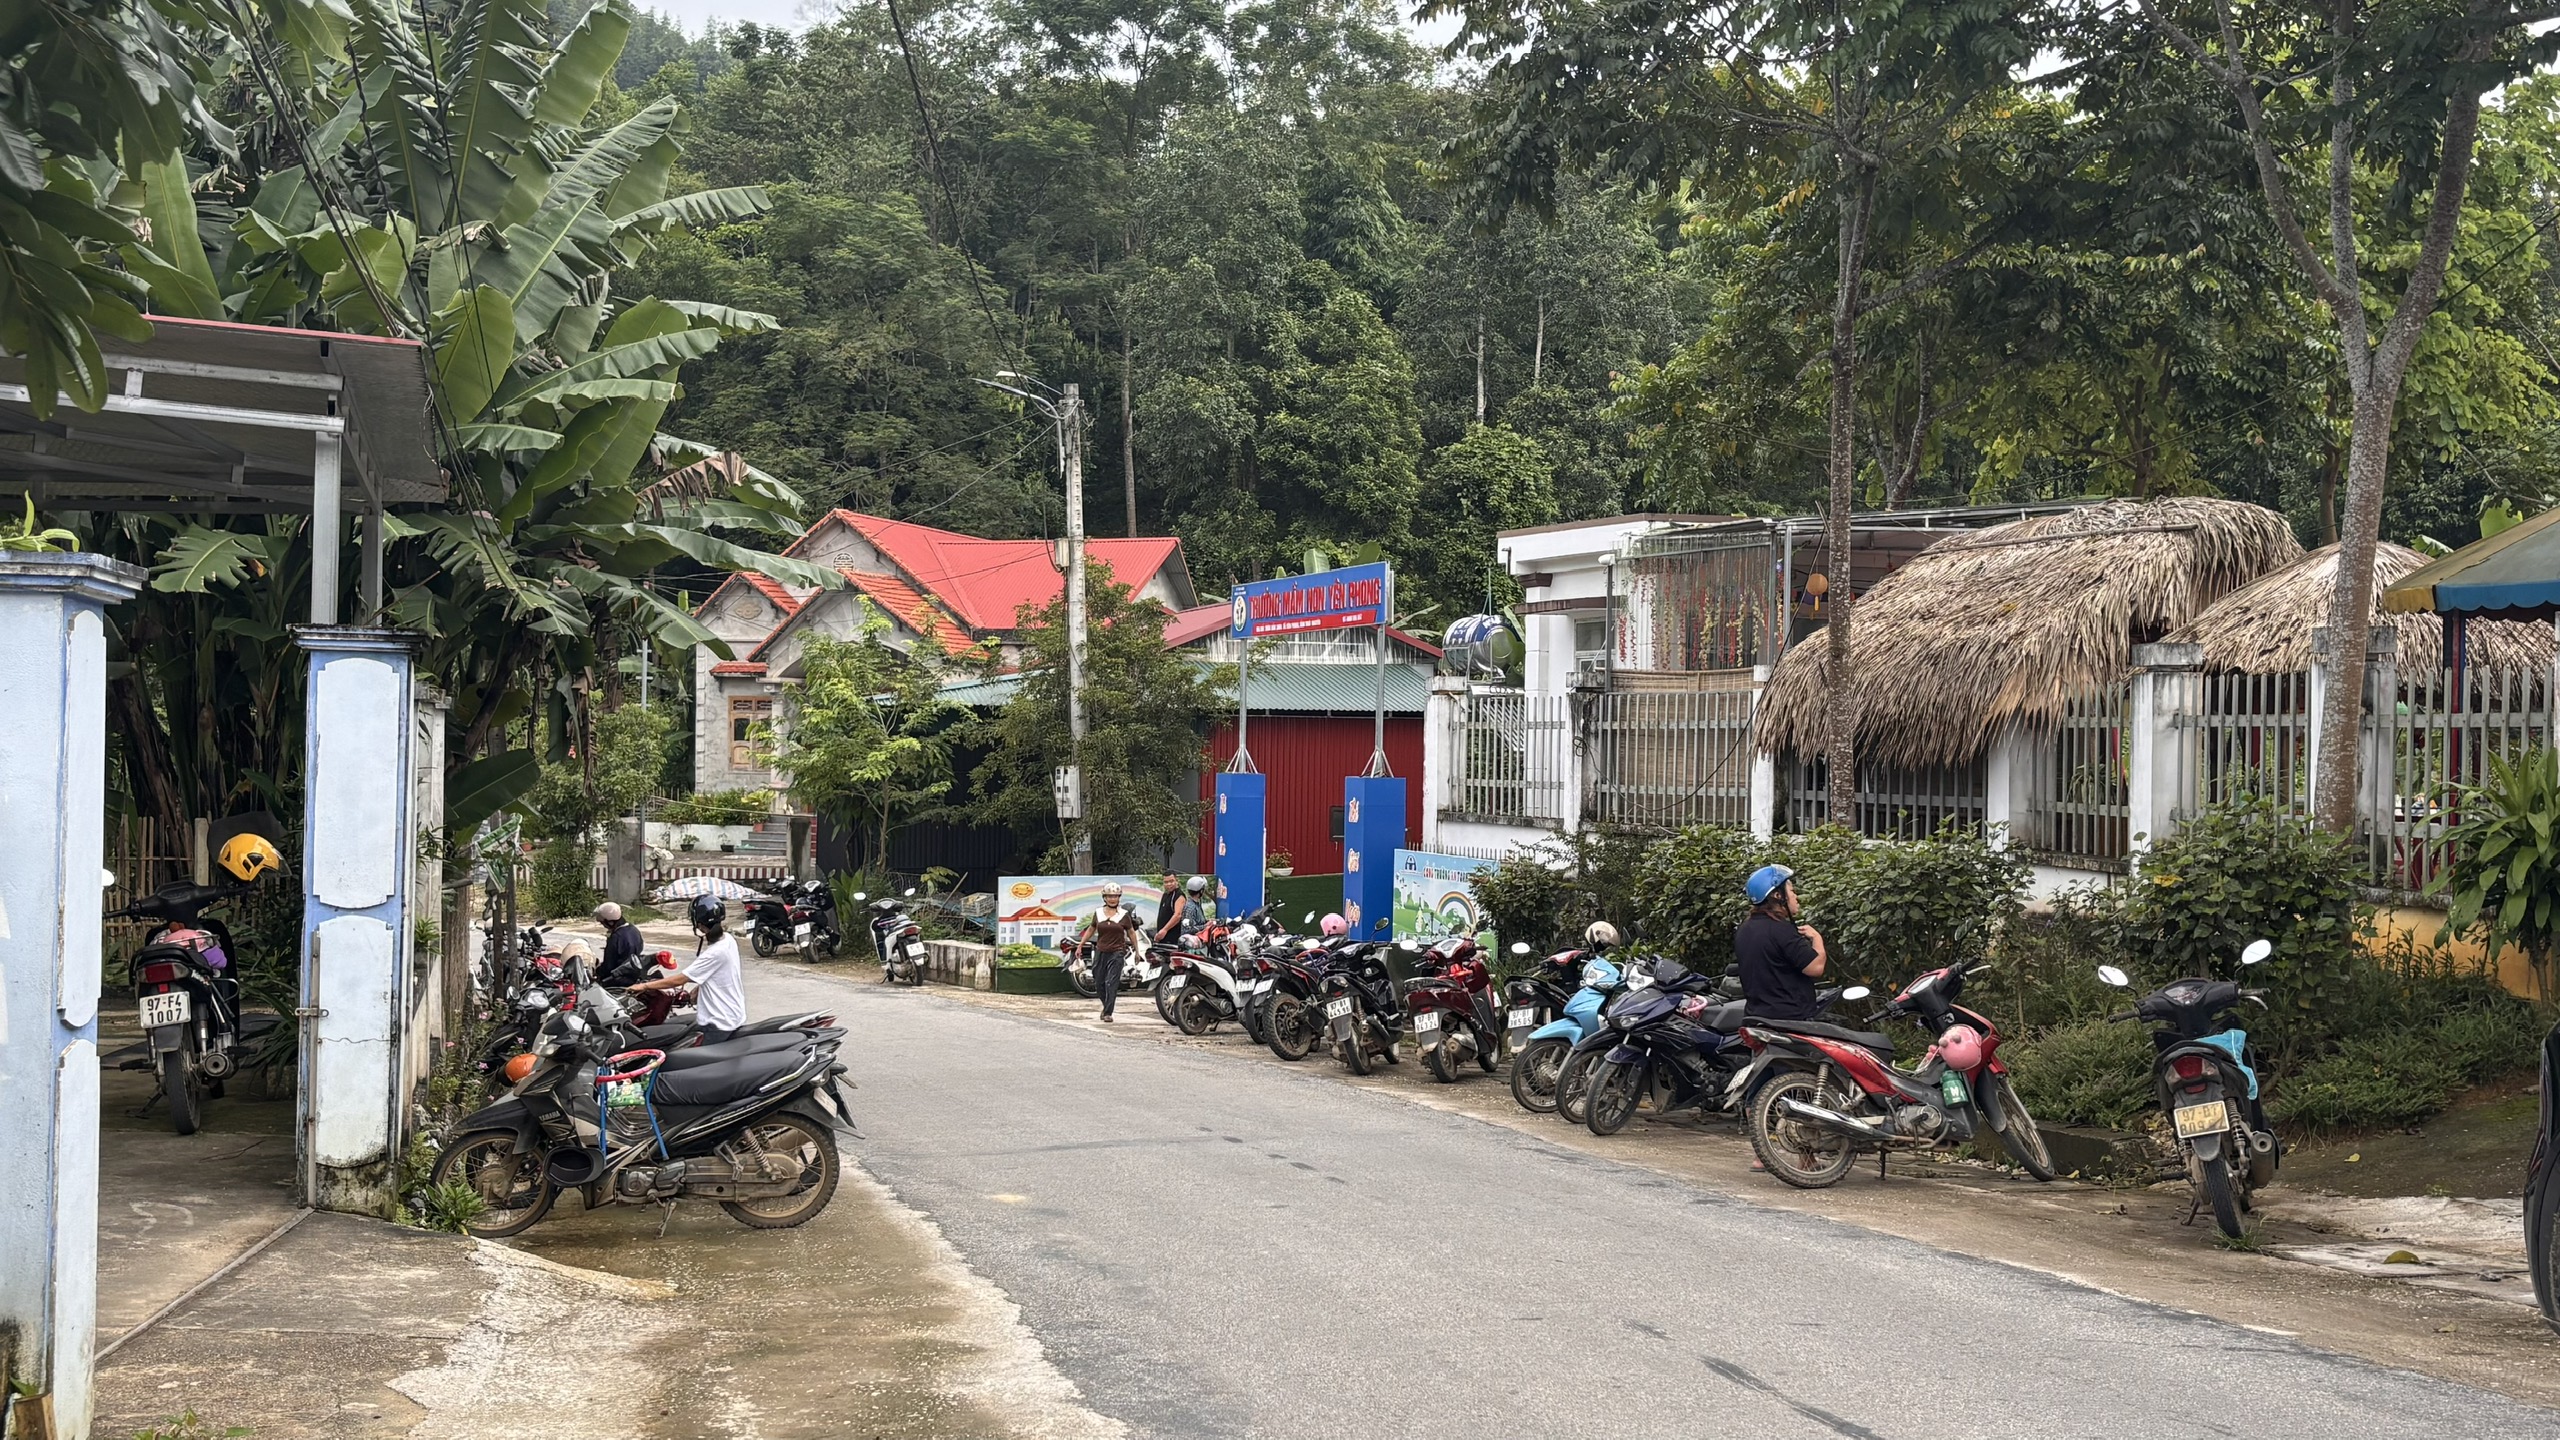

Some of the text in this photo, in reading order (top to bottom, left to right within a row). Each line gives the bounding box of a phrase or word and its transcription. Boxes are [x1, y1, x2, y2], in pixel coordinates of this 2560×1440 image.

[1248, 587, 1281, 620] TRƯỜNG
[1307, 586, 1327, 613] NON
[1349, 578, 1382, 608] PHONG
[147, 994, 182, 1011] 97-F4
[149, 1008, 182, 1025] 1007
